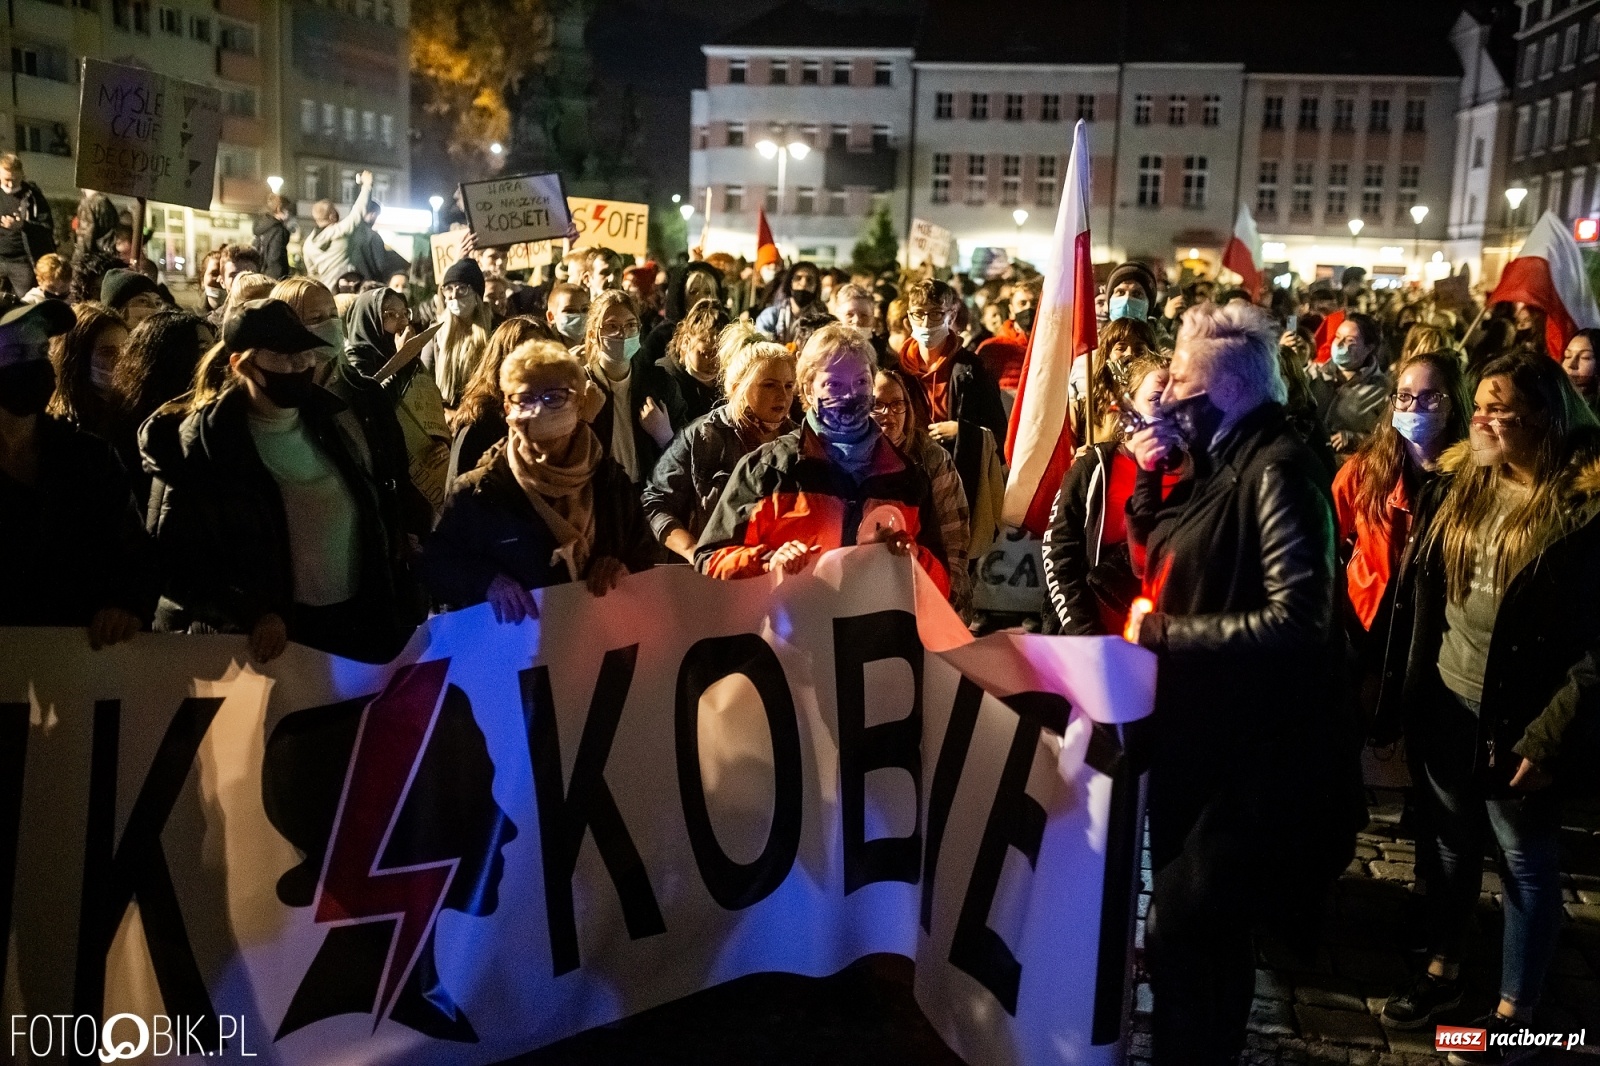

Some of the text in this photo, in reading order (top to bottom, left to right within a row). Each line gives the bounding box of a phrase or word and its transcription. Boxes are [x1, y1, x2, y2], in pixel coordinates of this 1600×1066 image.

[475, 201, 493, 212] OD
[485, 208, 550, 232] KOBIET!
[607, 210, 645, 240] OFF
[518, 609, 1145, 1046] KOBIET
